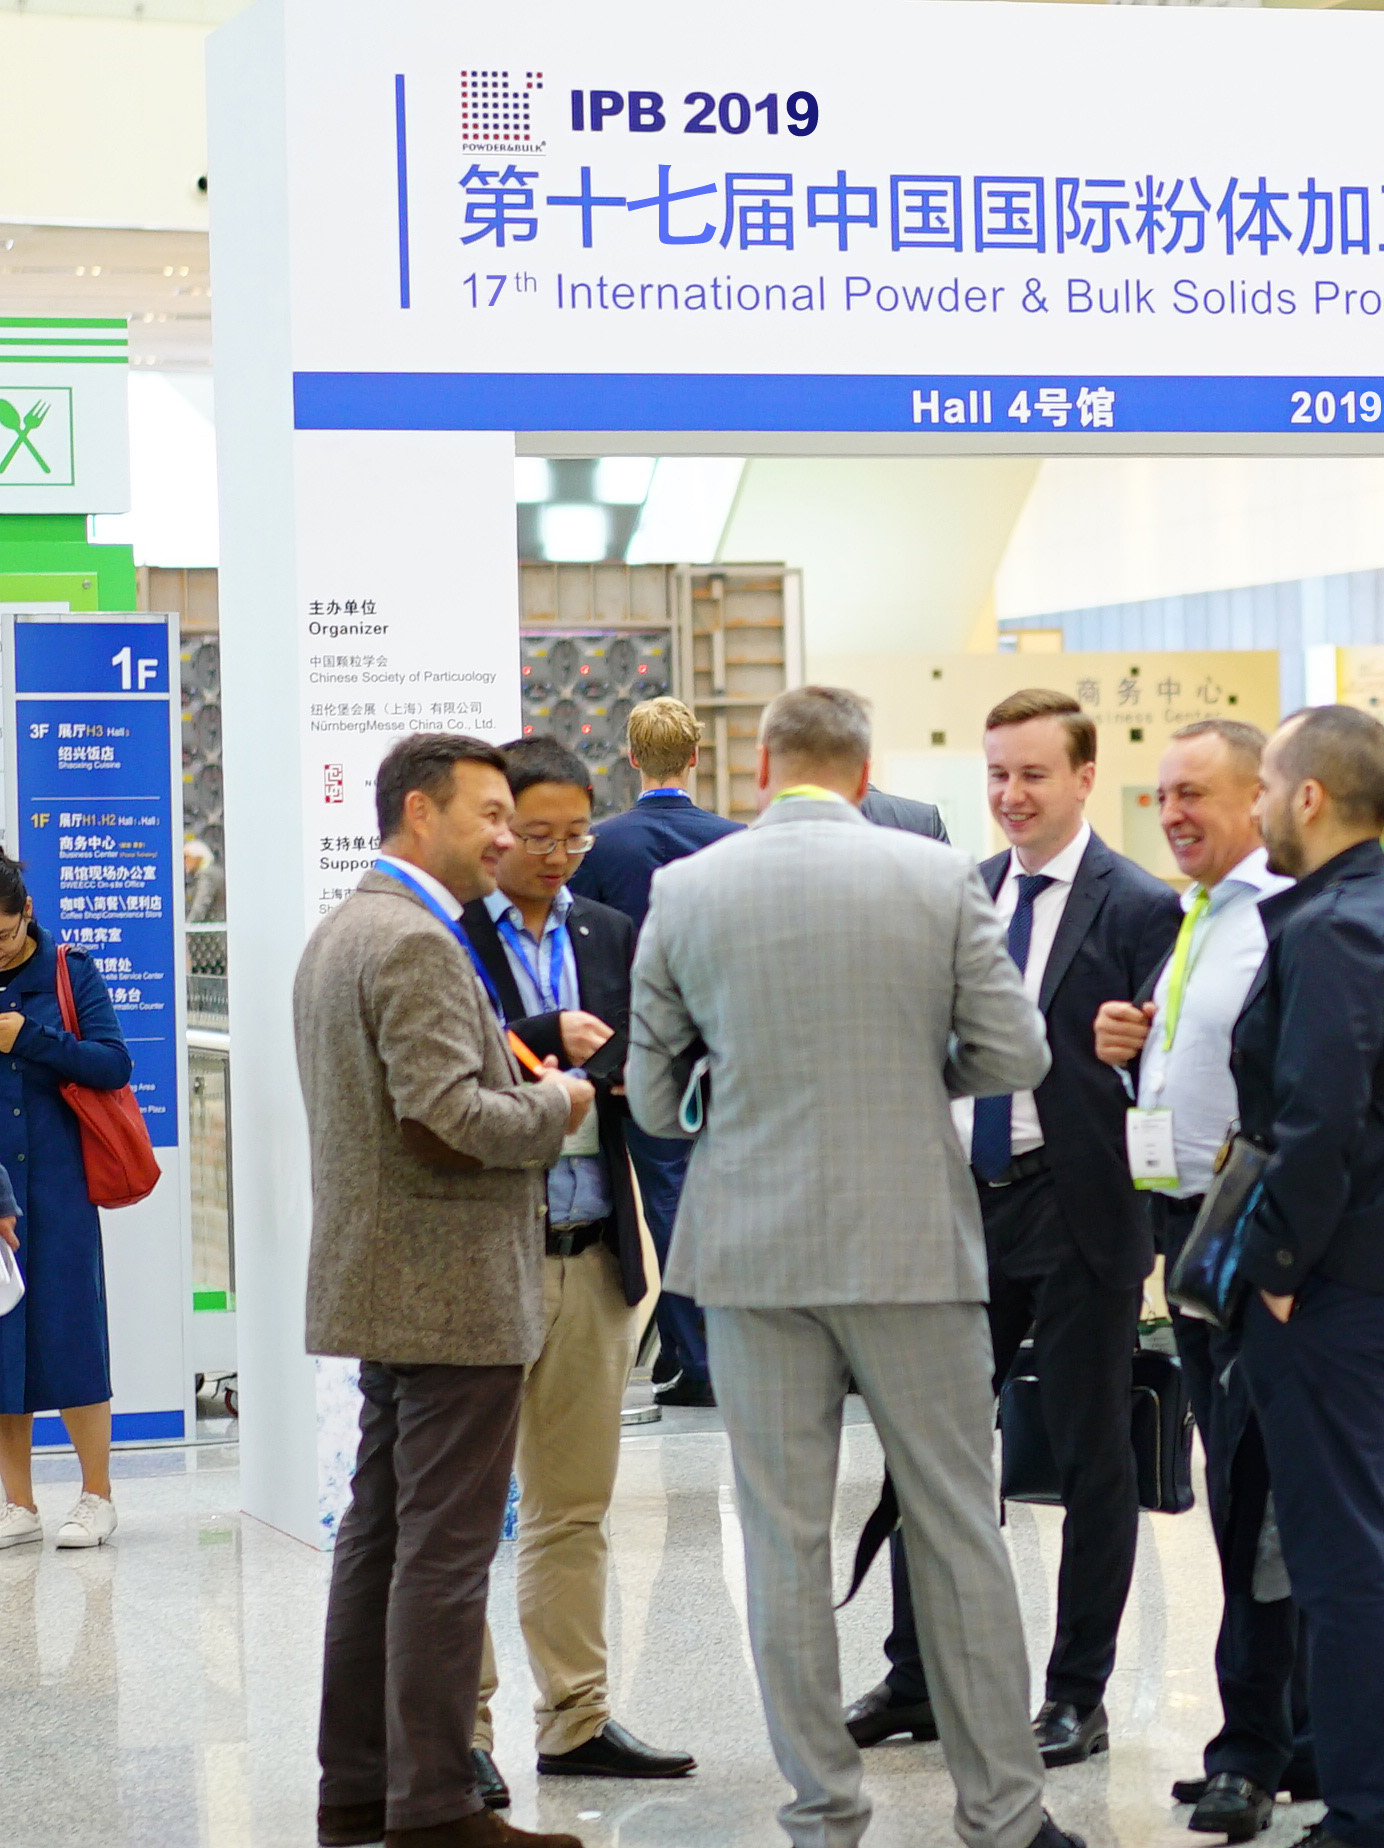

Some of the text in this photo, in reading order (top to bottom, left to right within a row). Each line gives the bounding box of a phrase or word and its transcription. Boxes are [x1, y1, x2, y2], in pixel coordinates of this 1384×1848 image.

[571, 90, 820, 137] IPB 2019
[557, 273, 825, 311] International
[845, 276, 1005, 312] Powder
[1021, 278, 1050, 313] &
[1067, 278, 1156, 313] Bulk
[1172, 278, 1297, 314] Solids
[911, 386, 1118, 429] Hall 4号馆
[308, 599, 377, 616] 主办单位
[308, 620, 389, 637] Organizer
[111, 646, 158, 690] 1F
[309, 655, 389, 668] 中国颗粒学会
[309, 670, 497, 685] Chinese Society of Particuology
[29, 723, 50, 739] 3F
[408, 718, 443, 731] China
[474, 718, 496, 730] Ltd.
[31, 812, 51, 828] 1F
[59, 835, 117, 850] 商务中心
[319, 856, 376, 872] Suppor
